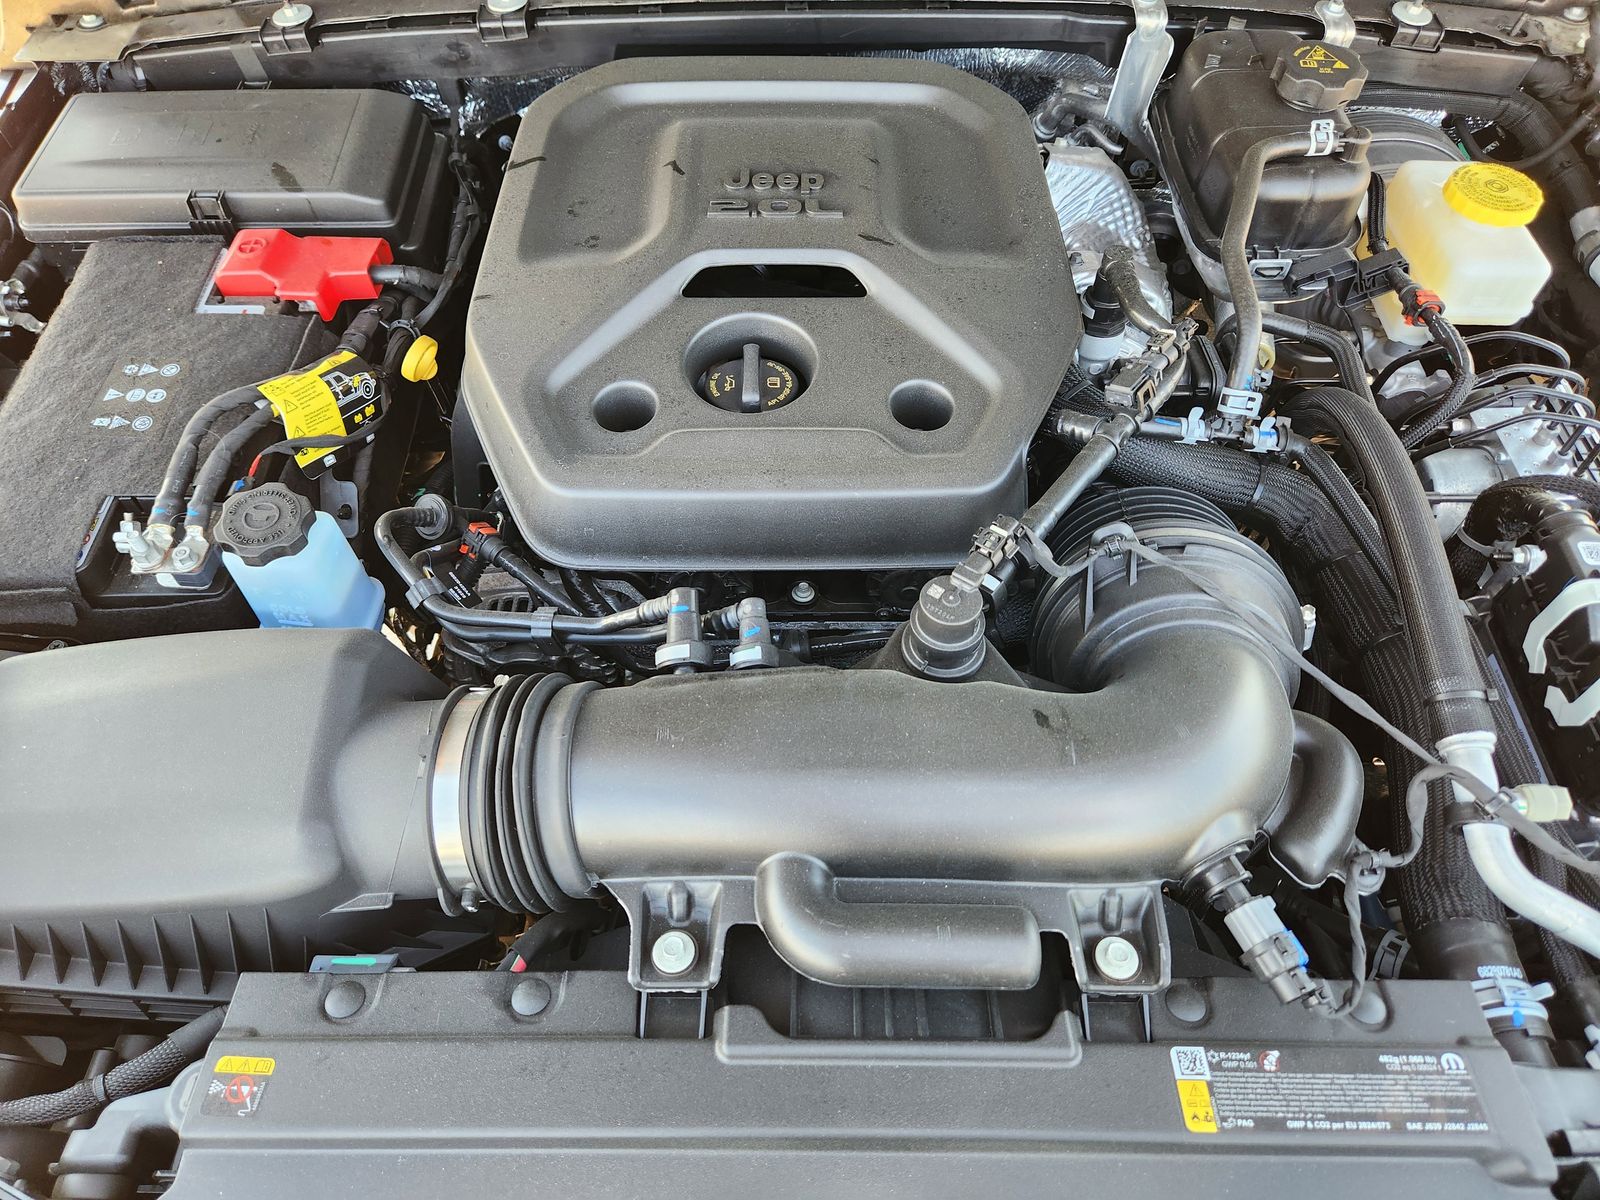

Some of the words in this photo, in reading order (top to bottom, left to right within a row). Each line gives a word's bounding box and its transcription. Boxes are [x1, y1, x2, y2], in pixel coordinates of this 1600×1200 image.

[722, 170, 824, 196] Jeep
[707, 198, 844, 218] 2.0L
[1237, 1119, 1254, 1128] PAG
[1286, 1120, 1305, 1128] GWP
